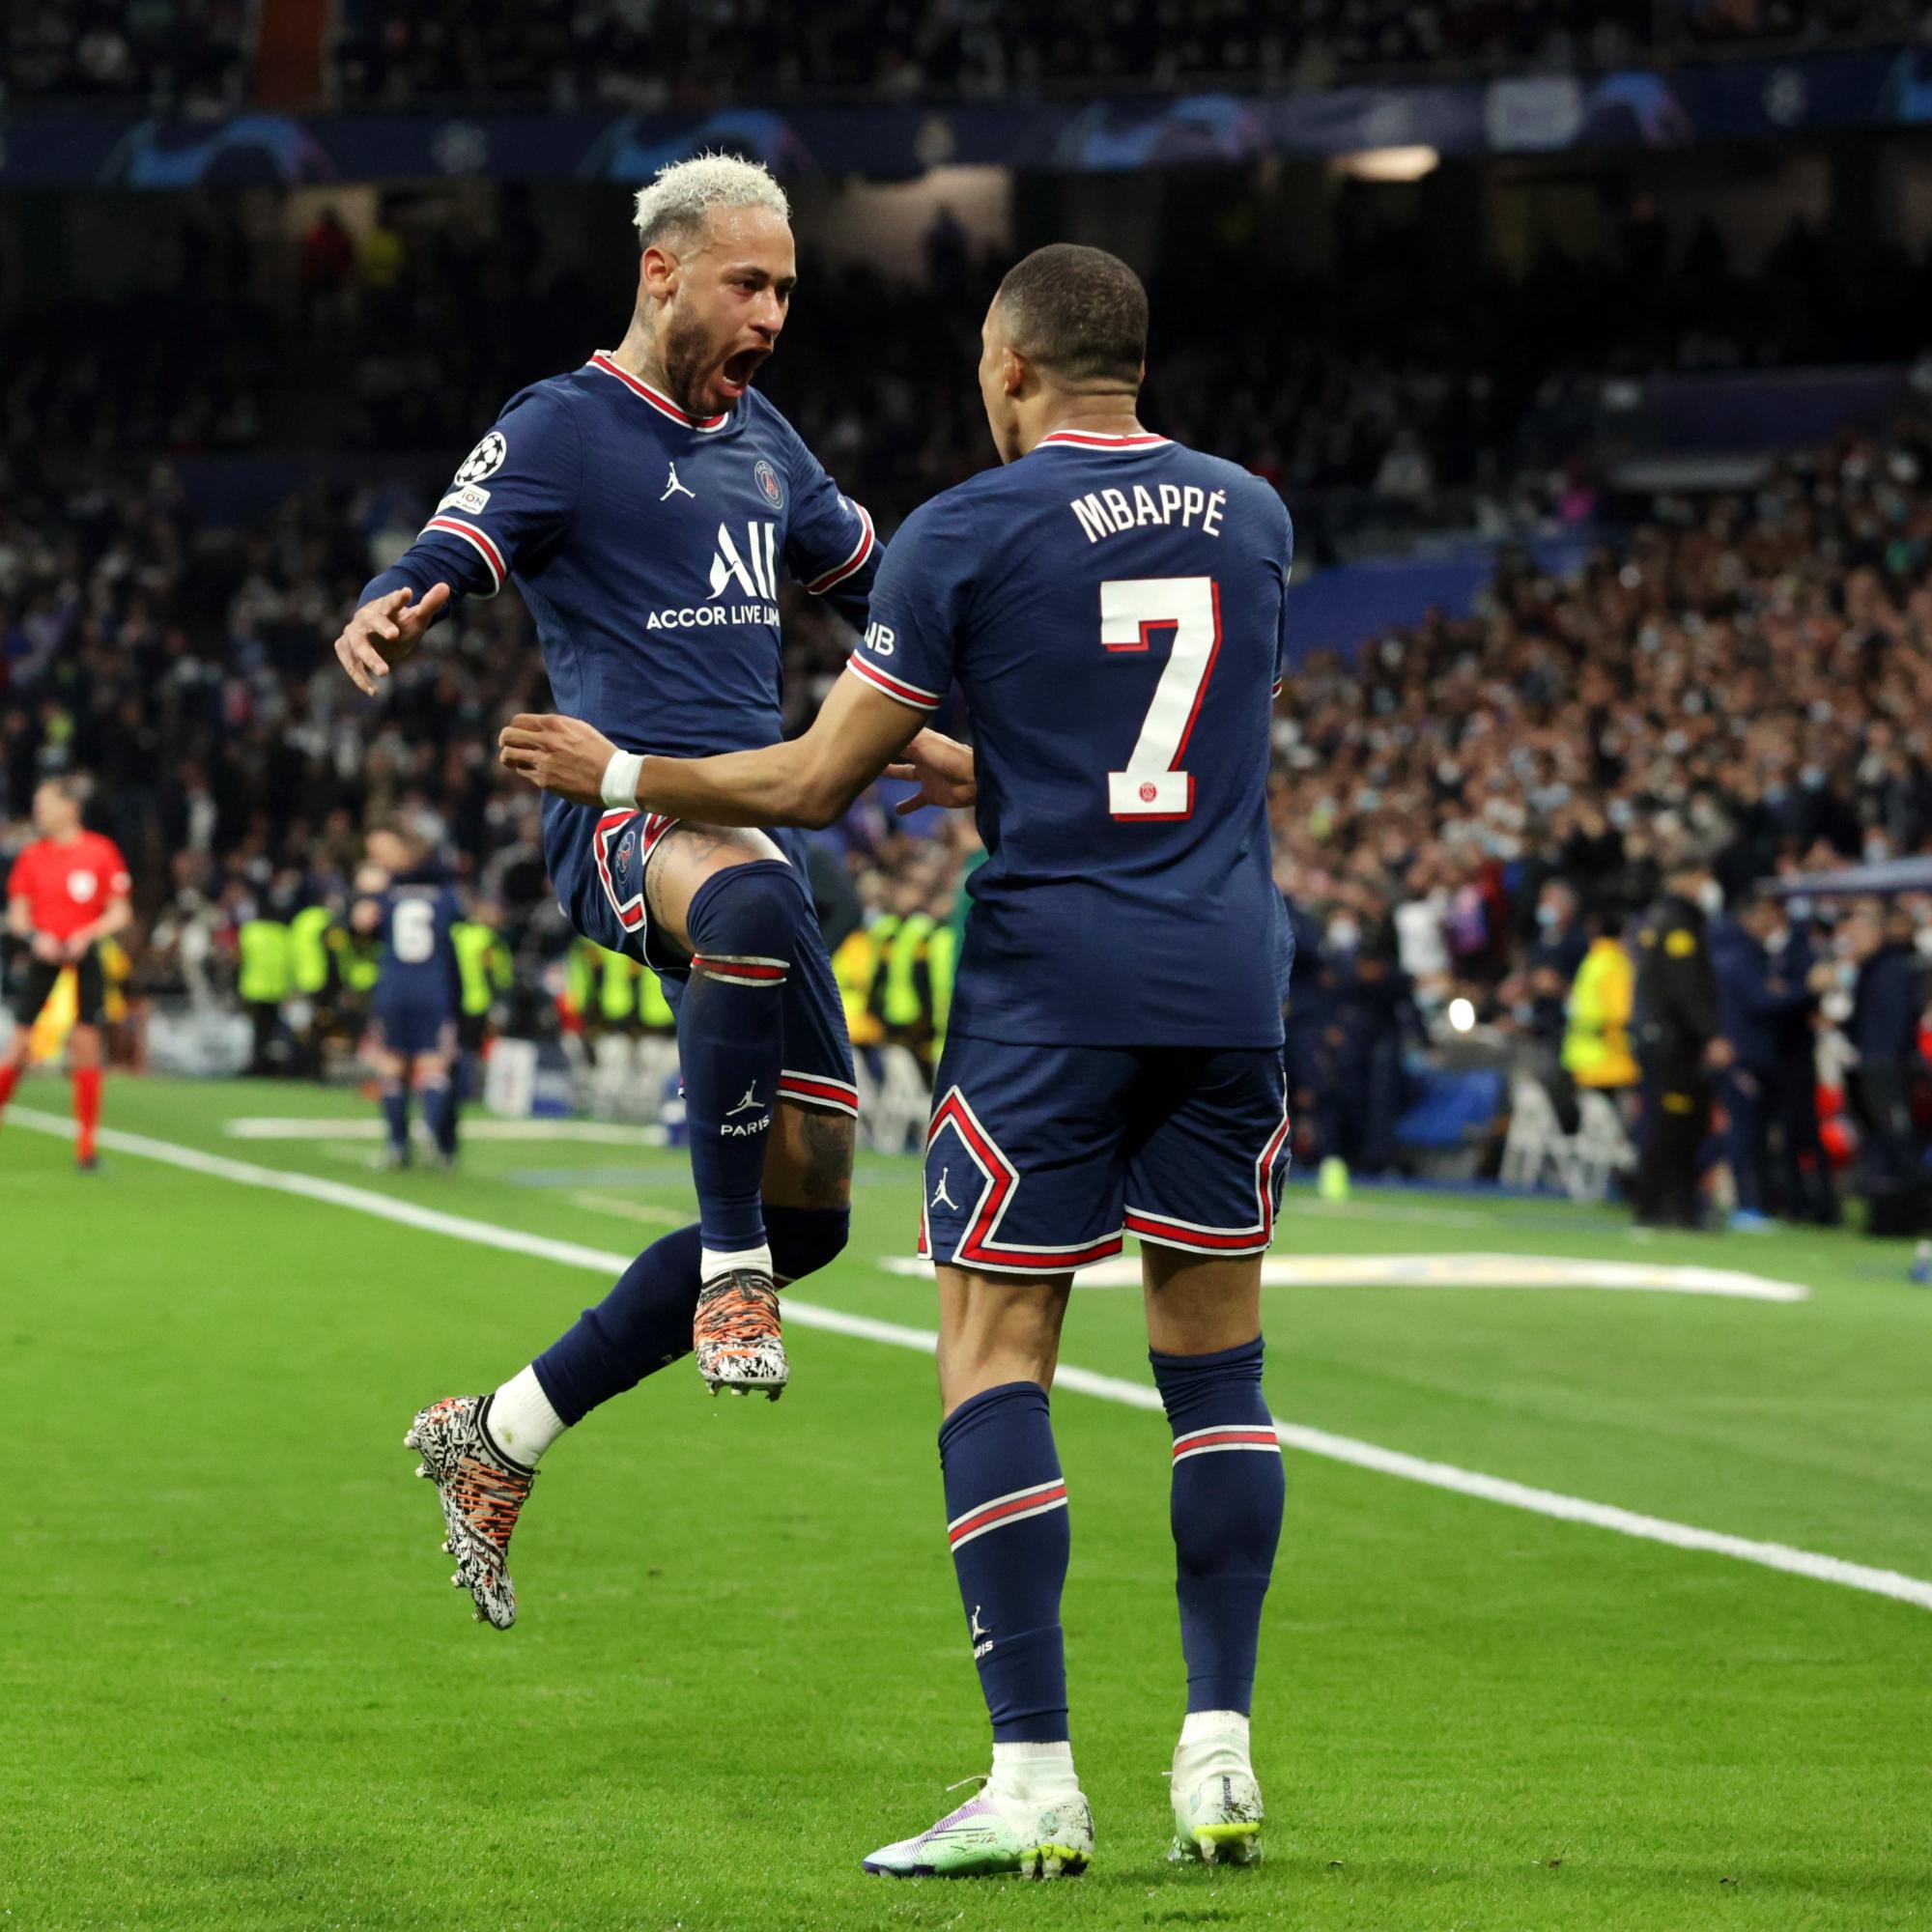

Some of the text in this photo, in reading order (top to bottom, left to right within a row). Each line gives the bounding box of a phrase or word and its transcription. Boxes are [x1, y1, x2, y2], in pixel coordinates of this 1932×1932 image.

[1070, 484, 1226, 544] MBAPPÉ
[646, 607, 727, 630] ACCOR
[731, 605, 761, 624] LIVE
[1100, 577, 1222, 821] 7
[392, 898, 435, 963] 6
[721, 1115, 770, 1136] PARIS
